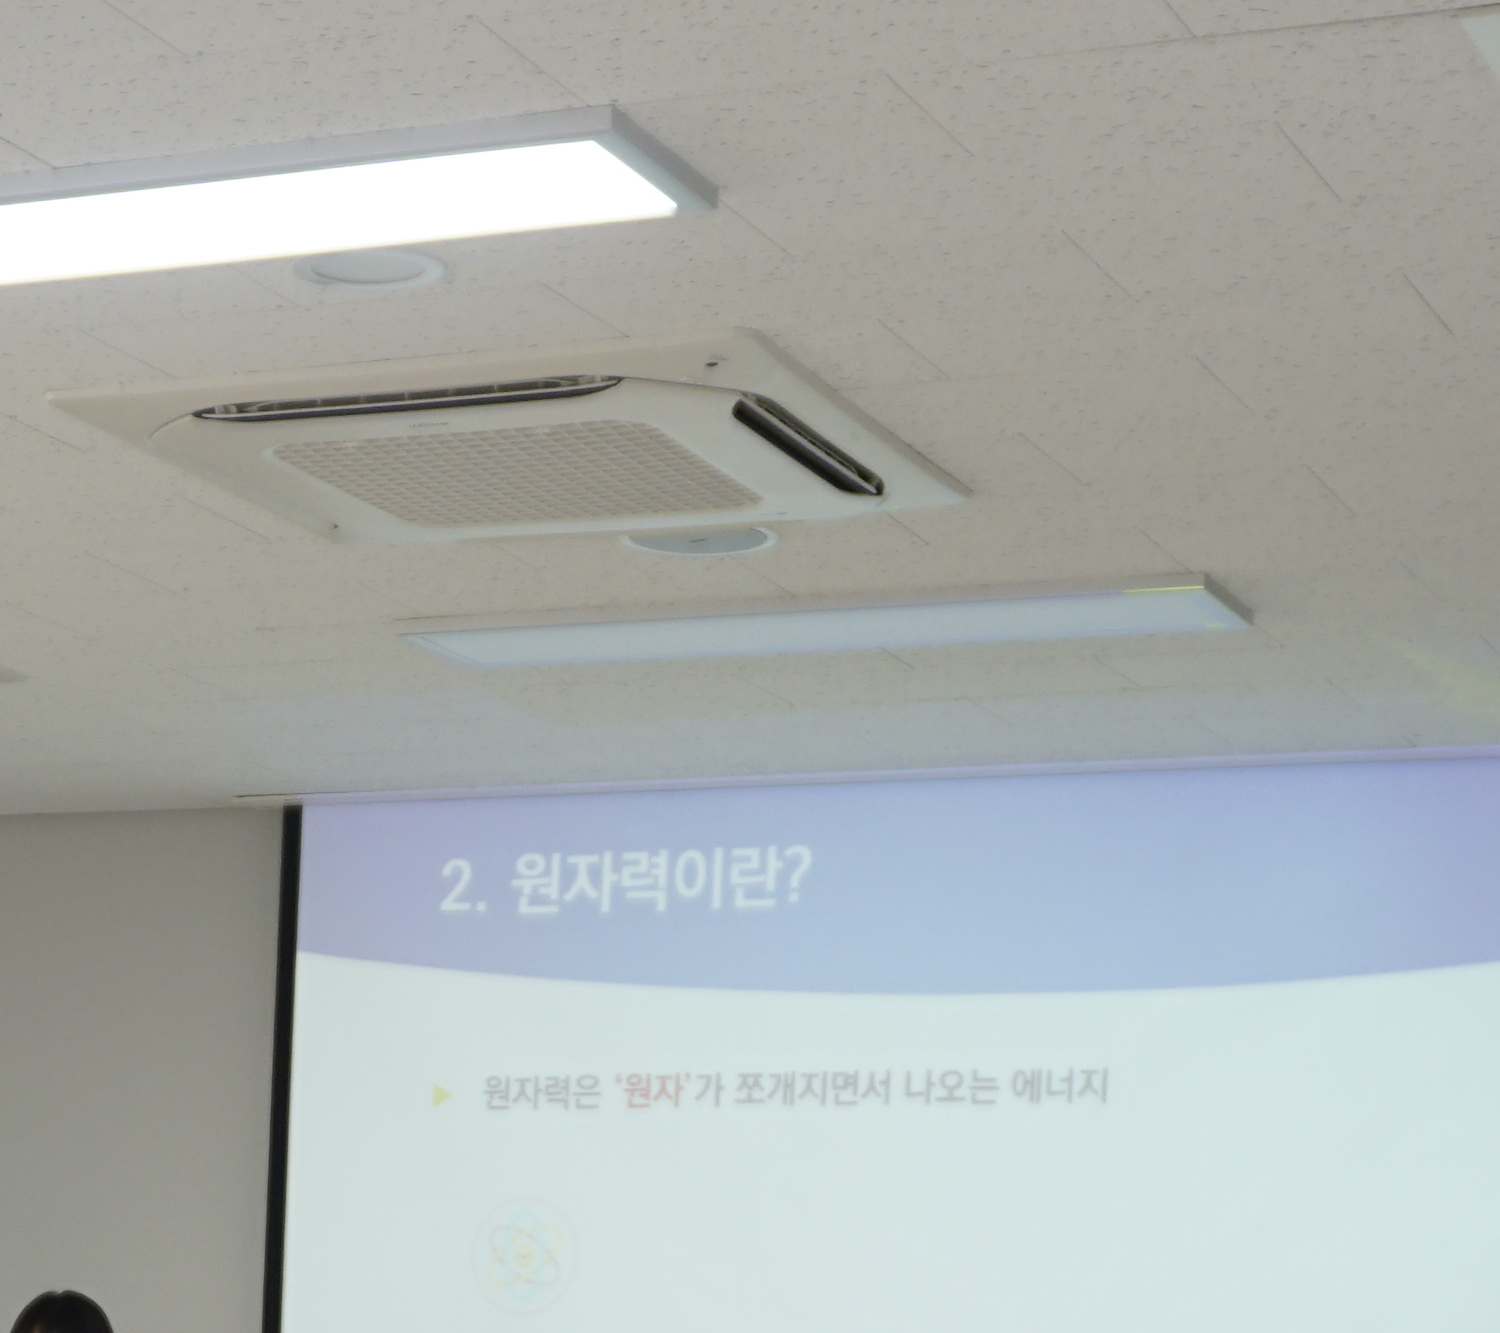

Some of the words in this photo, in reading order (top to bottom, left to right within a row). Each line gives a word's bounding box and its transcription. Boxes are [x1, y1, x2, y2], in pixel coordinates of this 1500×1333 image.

[440, 857, 488, 914] 2.
[510, 843, 814, 915] 원자력이란?
[483, 1074, 602, 1111] 원자력은
[735, 1069, 892, 1106] 쪼개지면서
[904, 1068, 1000, 1105] 나오는
[1009, 1067, 1110, 1103] 에너지
